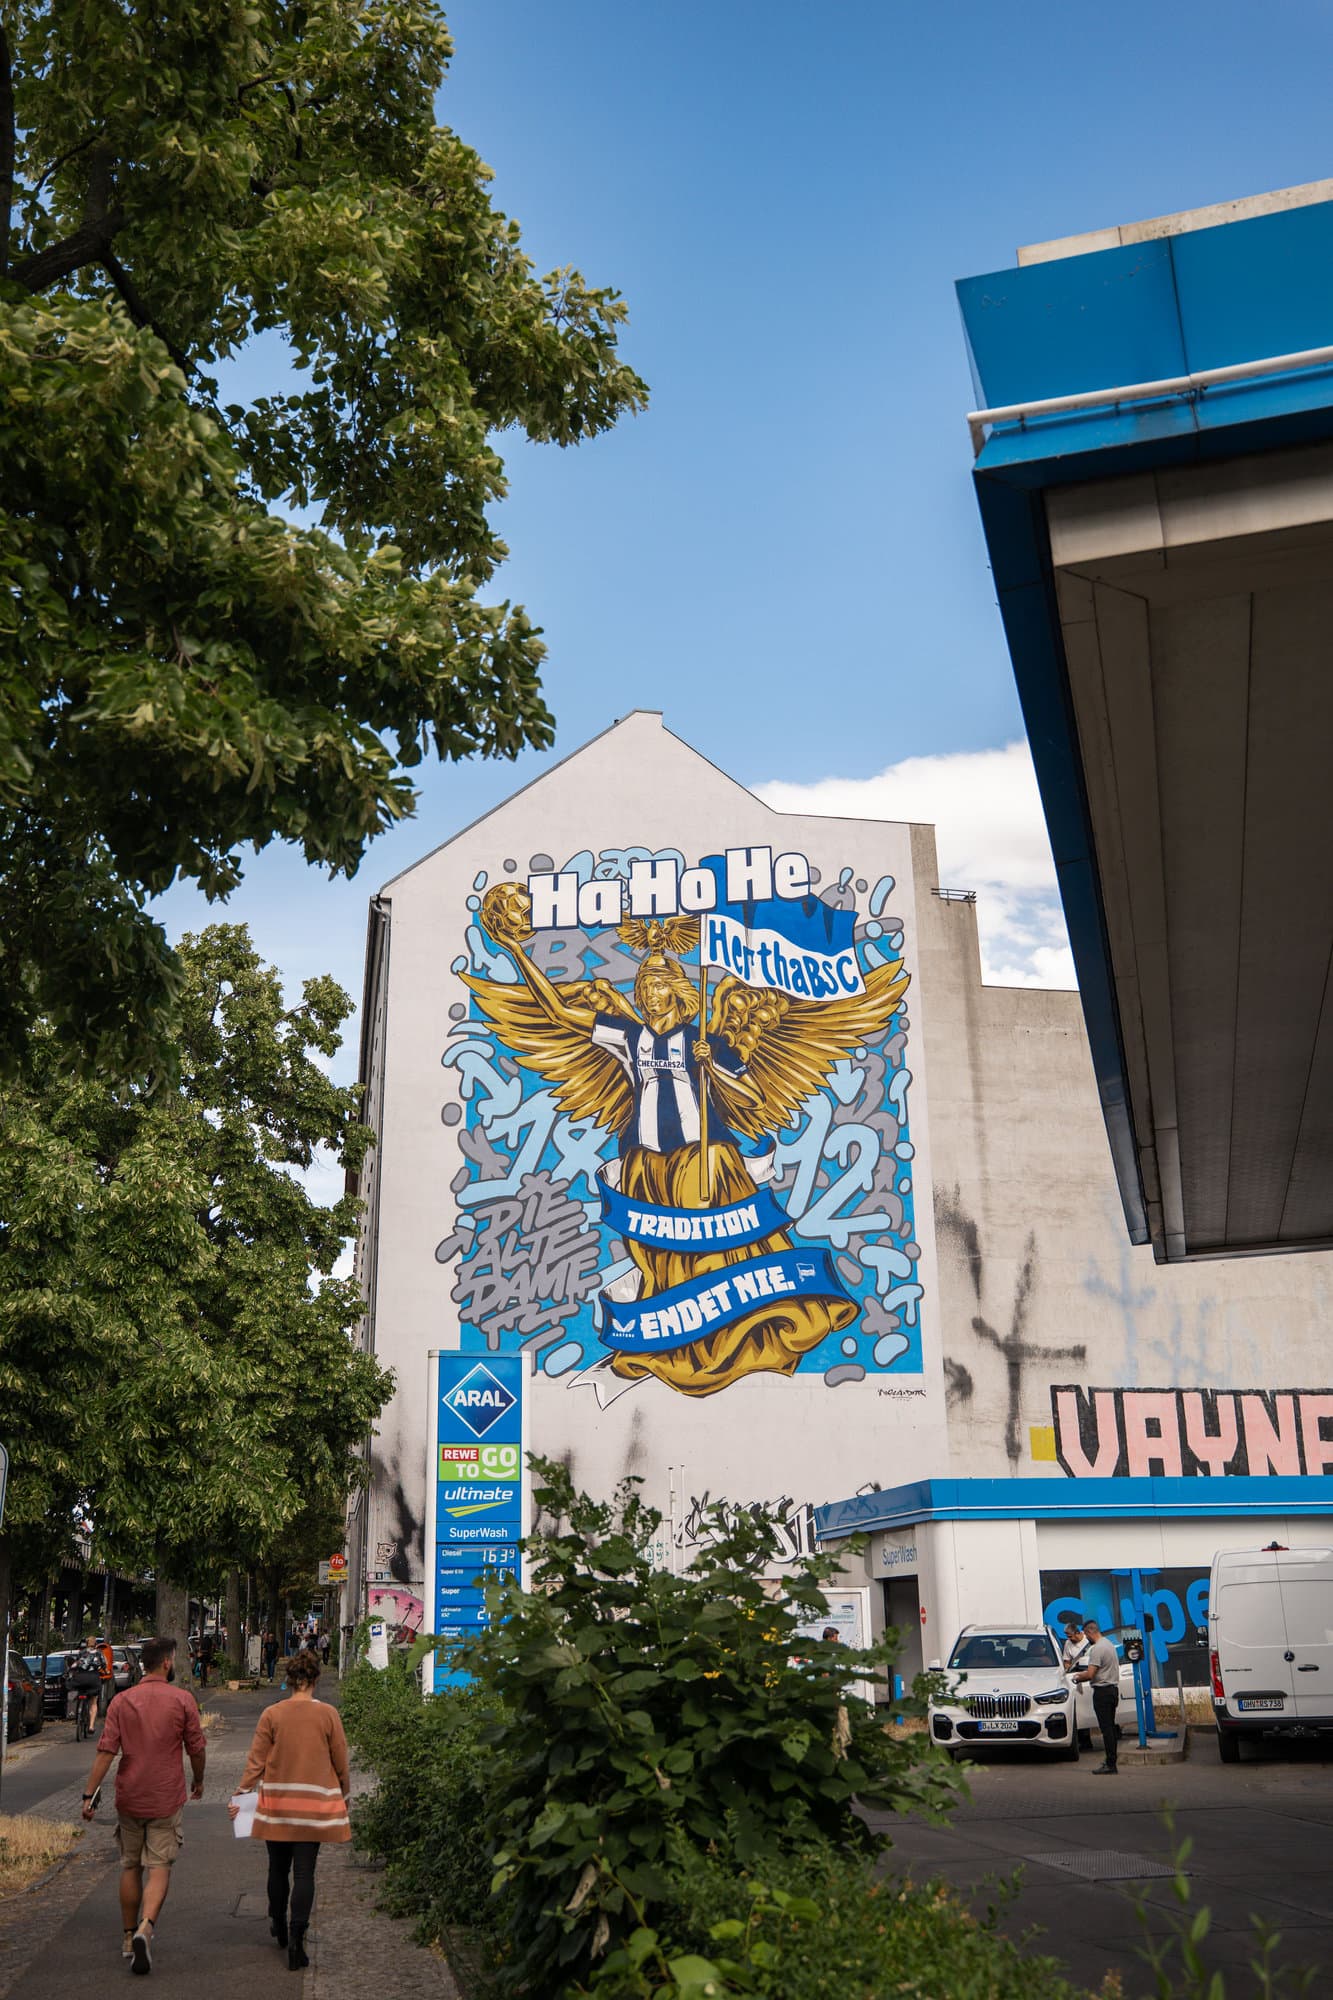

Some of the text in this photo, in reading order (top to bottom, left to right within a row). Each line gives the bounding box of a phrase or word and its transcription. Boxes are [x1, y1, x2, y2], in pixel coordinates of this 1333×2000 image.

[473, 1171, 586, 1246] DIE
[627, 1204, 760, 1241] TRADITION
[640, 1265, 796, 1340] ENDET NIE.
[453, 1390, 506, 1407] ARAL
[443, 1448, 517, 1467] REWE GO
[456, 1464, 480, 1478] TO
[444, 1487, 513, 1501] ultimate
[449, 1527, 508, 1539] SuperWash
[441, 1549, 462, 1557] Diesel
